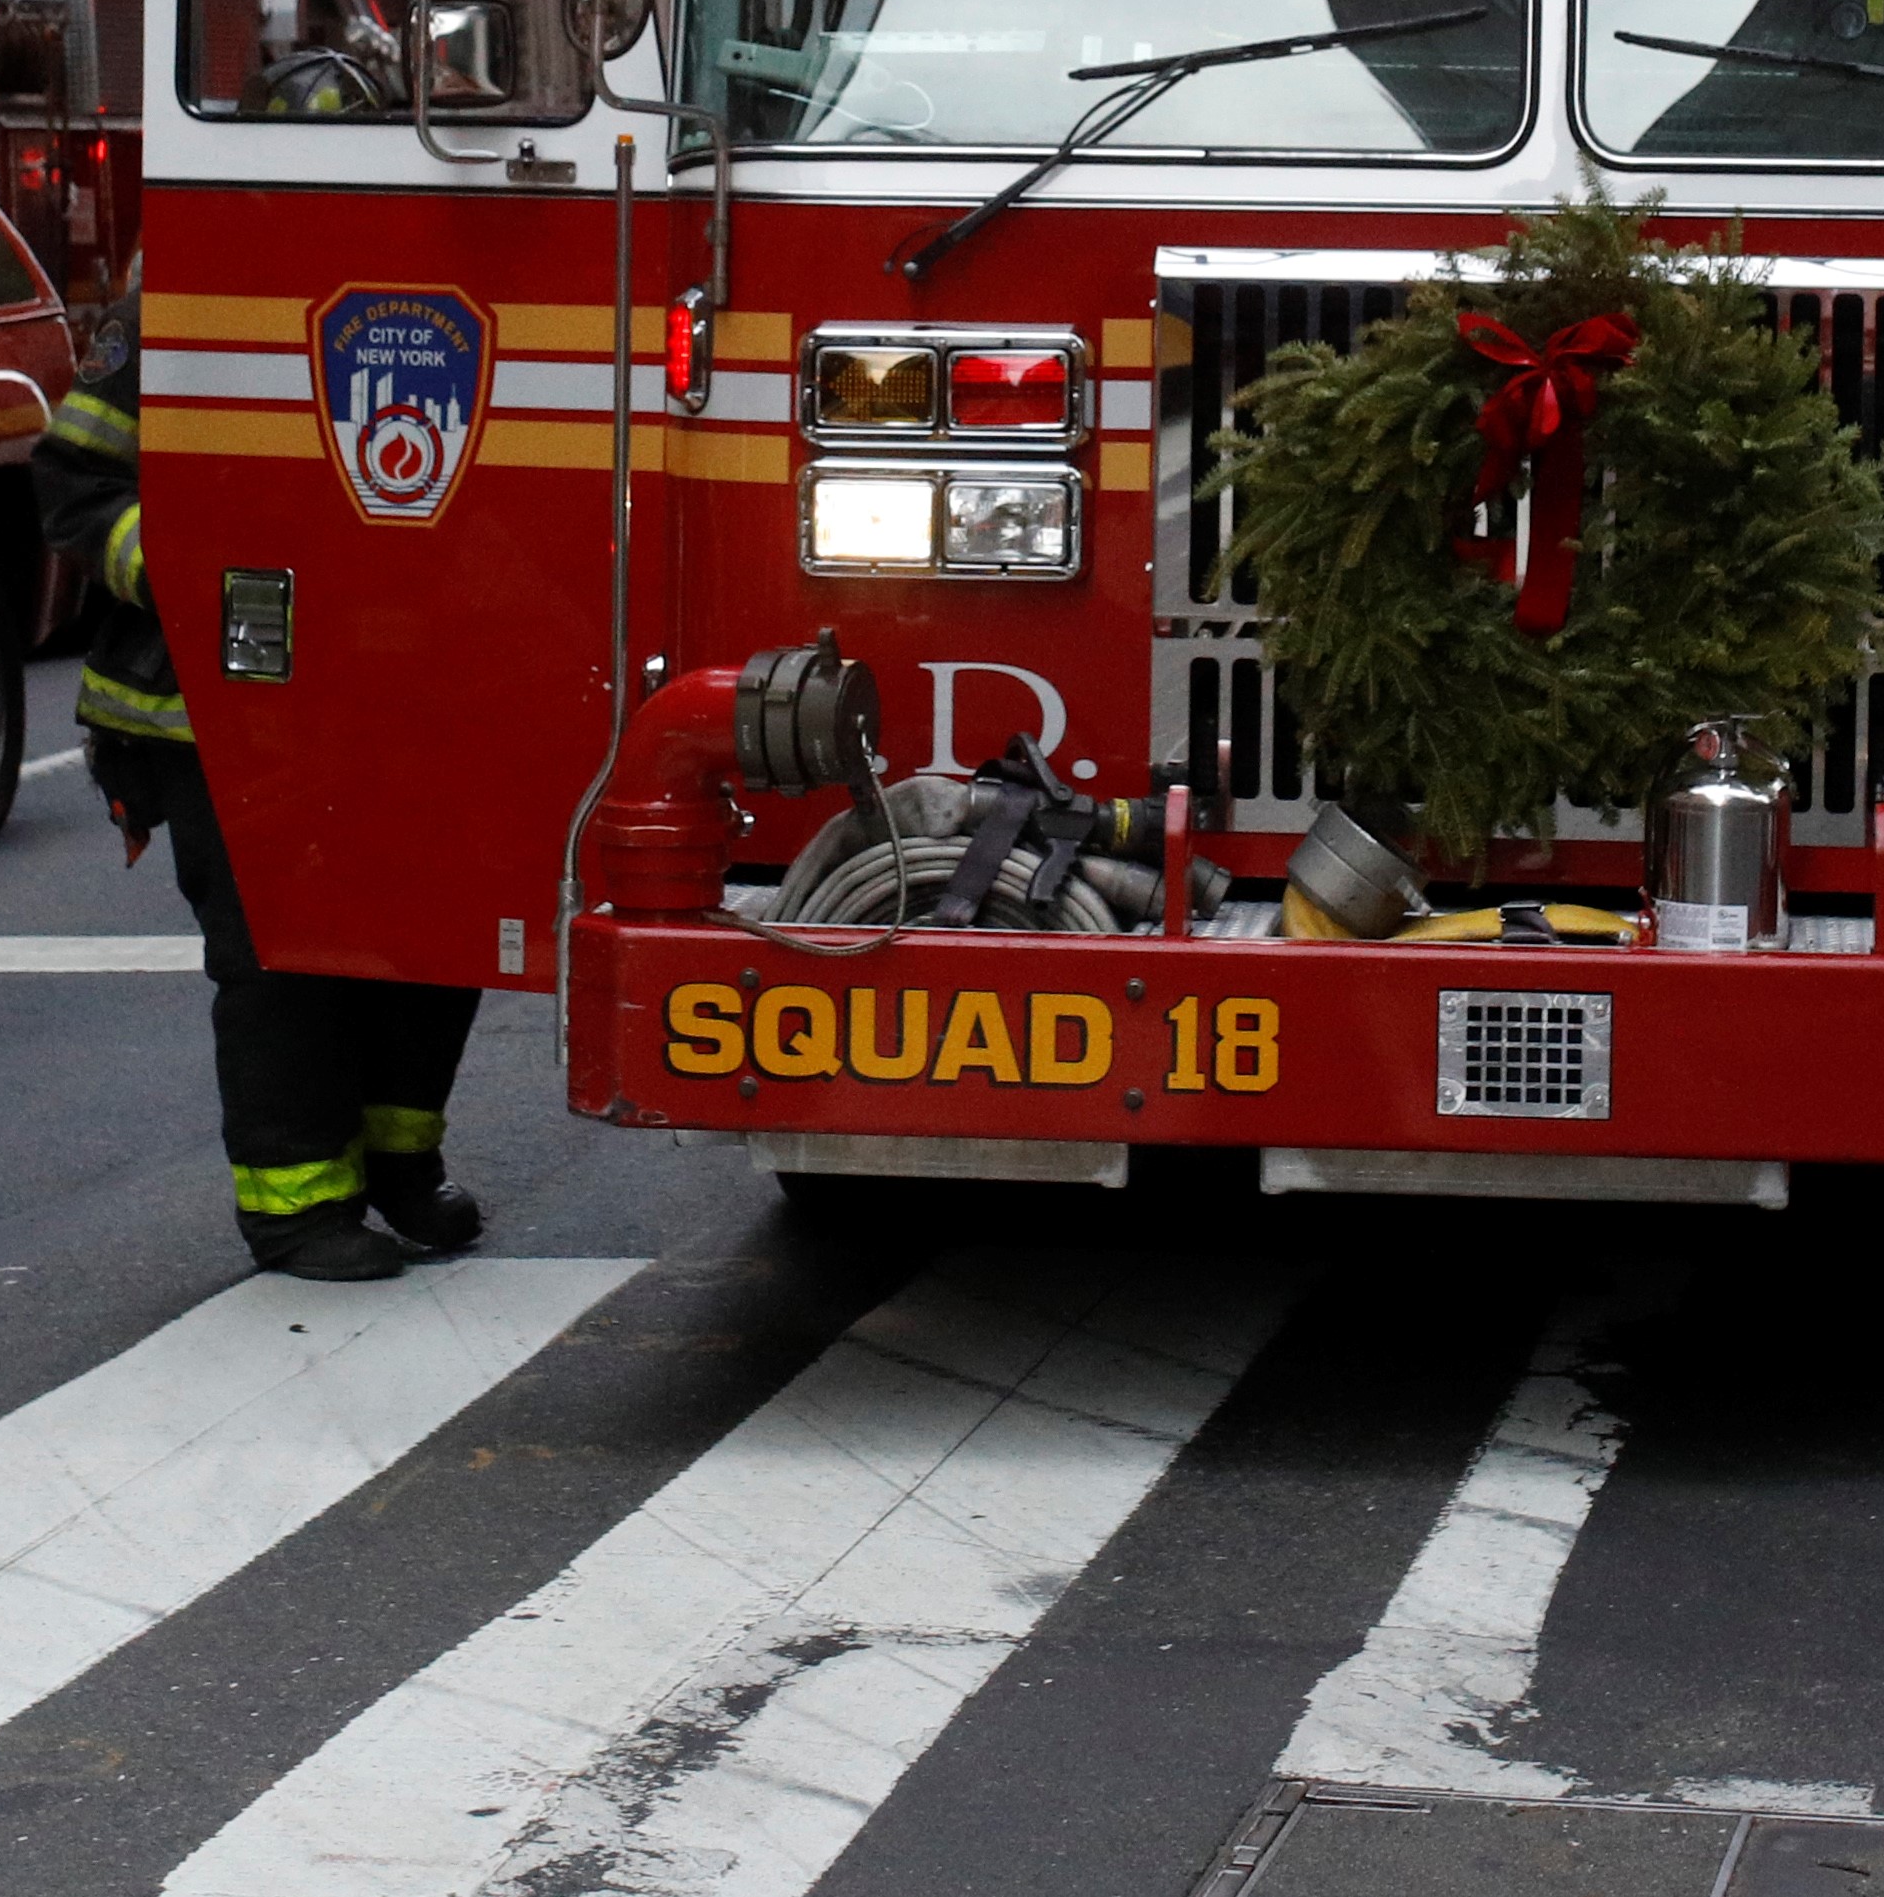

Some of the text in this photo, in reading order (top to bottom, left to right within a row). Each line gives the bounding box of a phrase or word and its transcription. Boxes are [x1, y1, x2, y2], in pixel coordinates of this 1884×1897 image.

[333, 301, 470, 353] FIRE DEPARTMENT
[368, 327, 433, 345] CITY OF
[356, 347, 446, 367] NEW YORK
[667, 982, 1280, 1093] SQUAD 18
